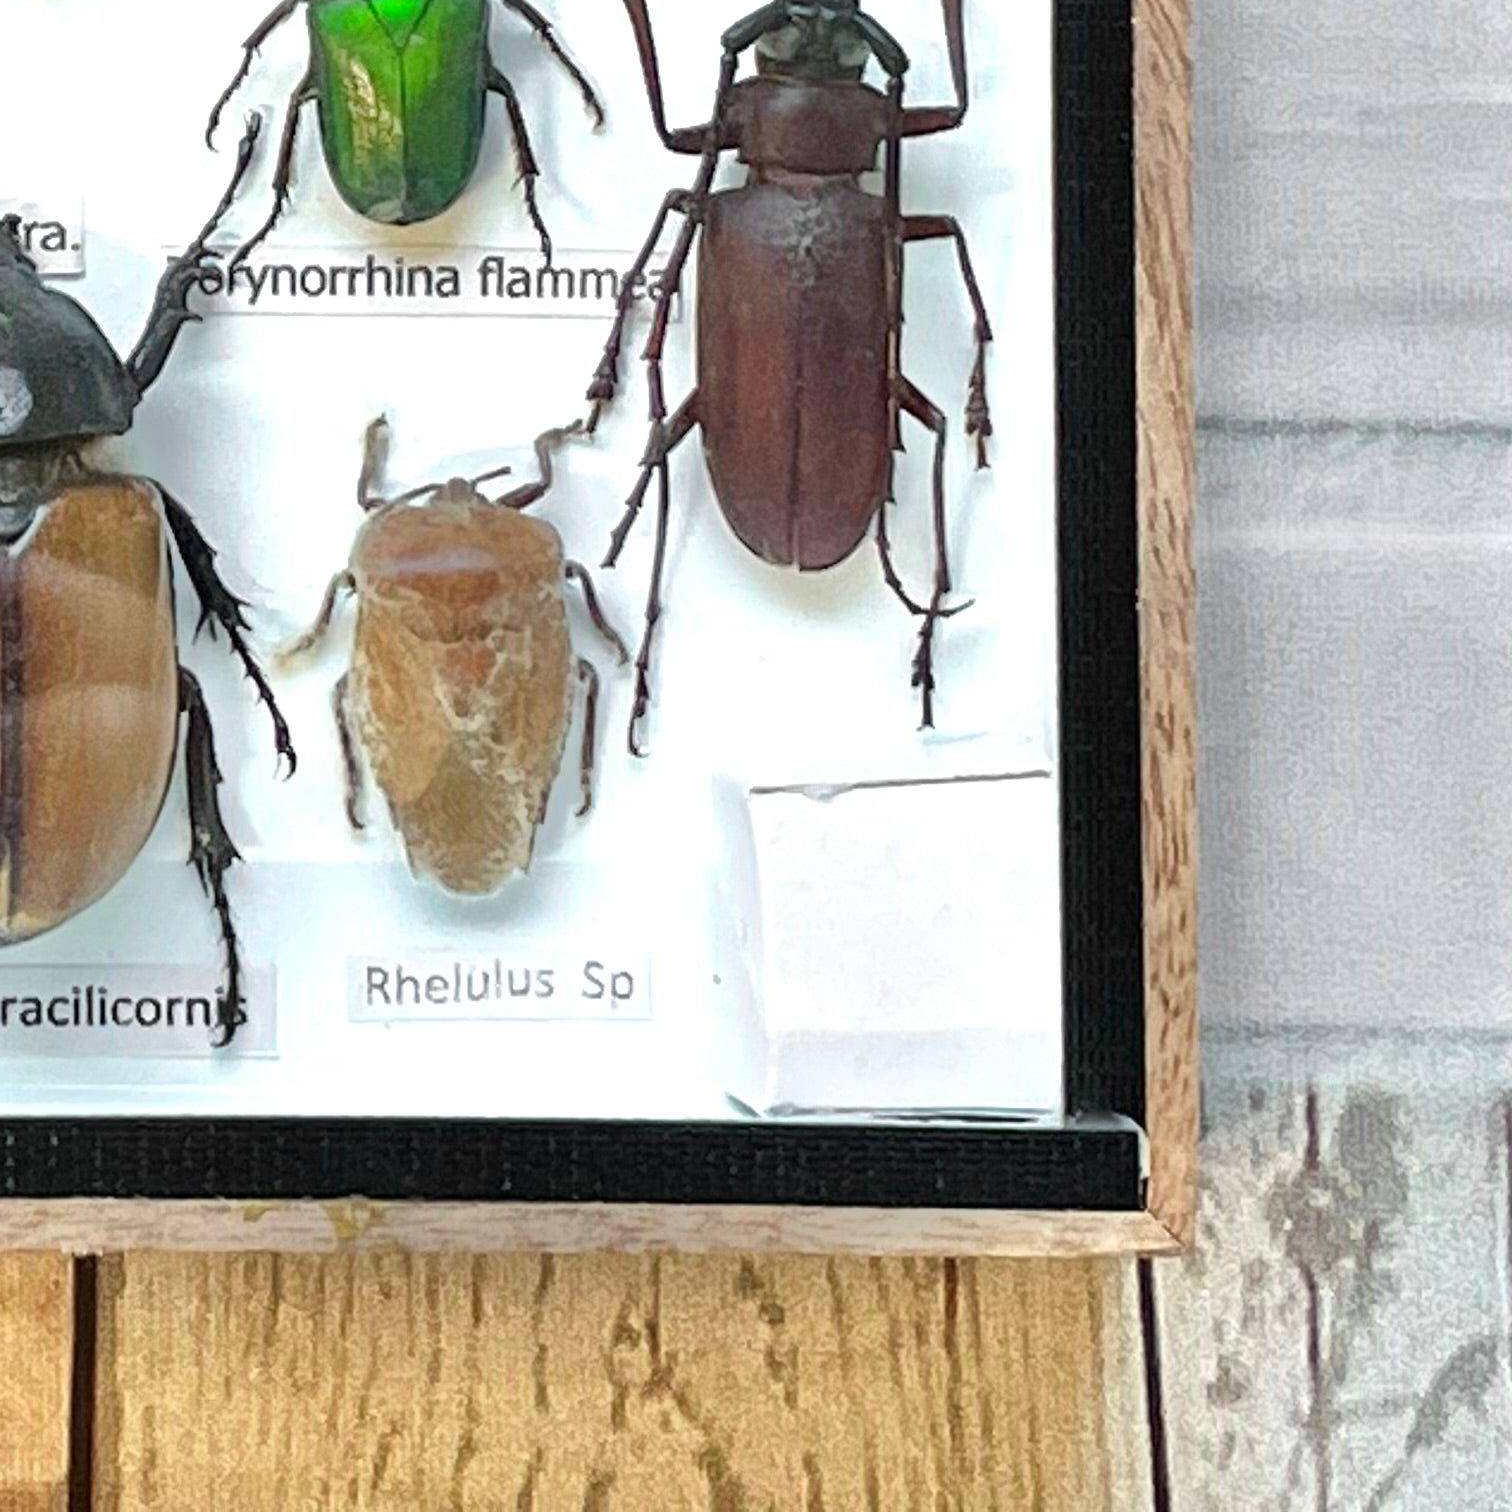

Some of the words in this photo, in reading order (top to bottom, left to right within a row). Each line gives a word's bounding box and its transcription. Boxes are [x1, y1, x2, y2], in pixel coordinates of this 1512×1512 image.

[168, 254, 461, 306] orynorrhina
[366, 957, 555, 1007] Rhelulus
[581, 960, 634, 1010] Sp
